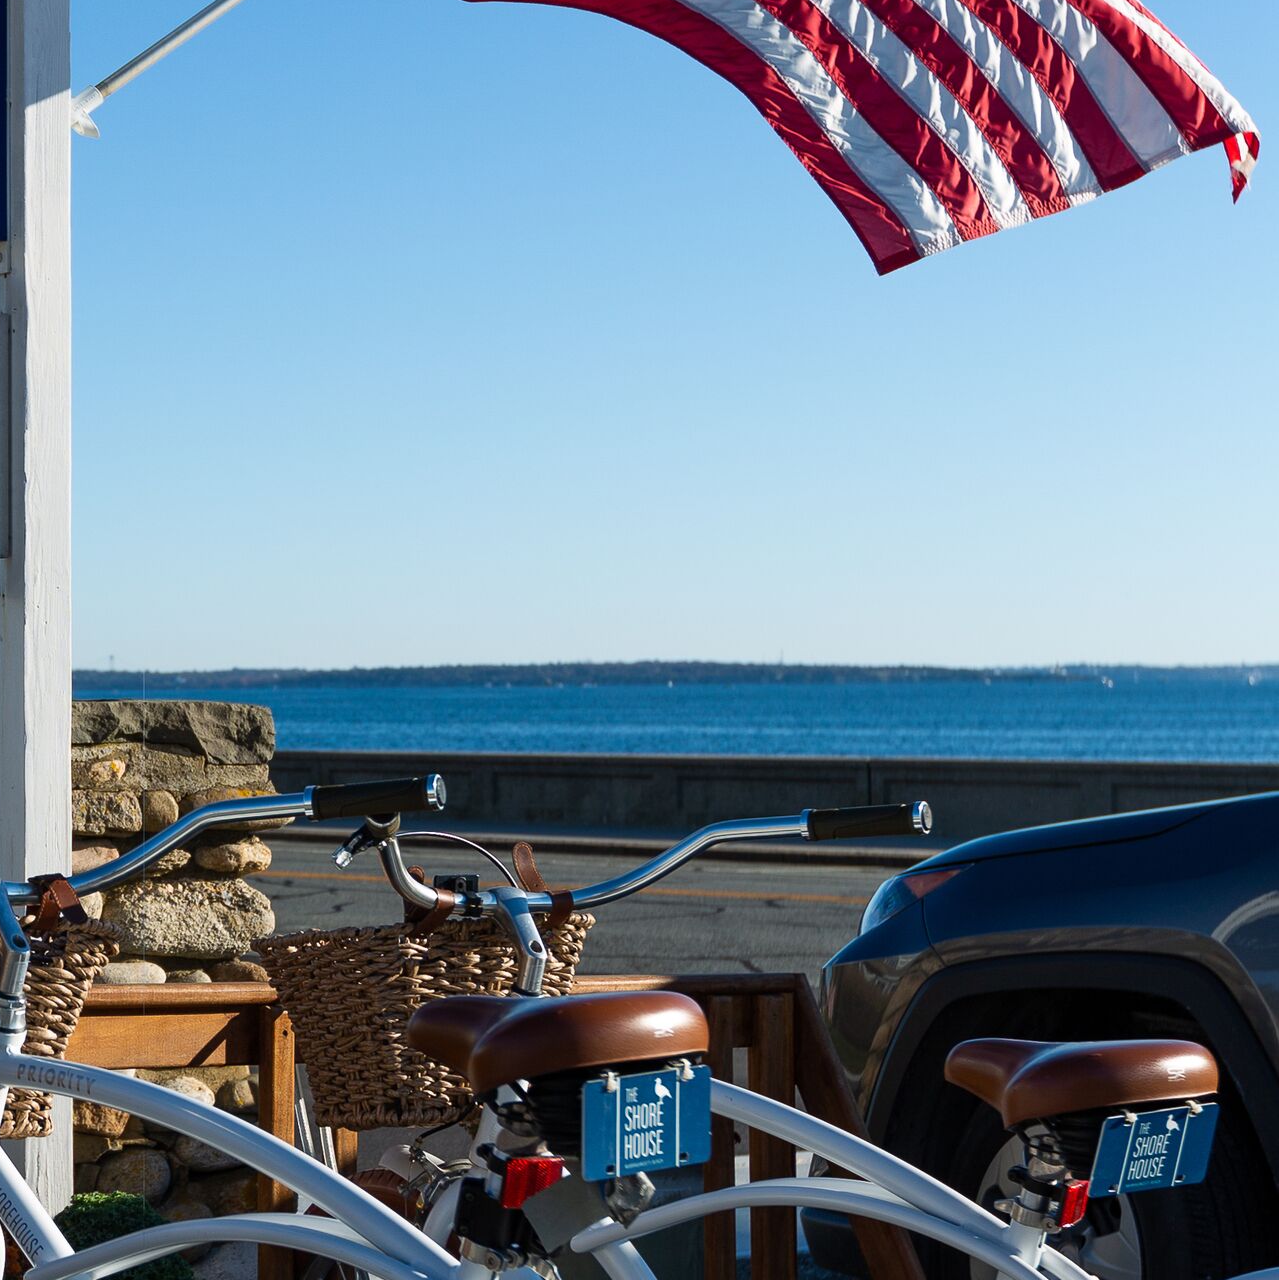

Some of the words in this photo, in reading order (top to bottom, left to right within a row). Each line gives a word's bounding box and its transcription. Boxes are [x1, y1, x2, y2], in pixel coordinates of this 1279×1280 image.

[16, 1062, 97, 1096] PRIORITY
[624, 1086, 639, 1104] THE
[623, 1101, 665, 1132] SHORE
[1138, 1121, 1152, 1135] THE
[623, 1129, 665, 1160] HOUSE
[1132, 1133, 1172, 1158] SHORE
[1127, 1156, 1167, 1180] HOUSE
